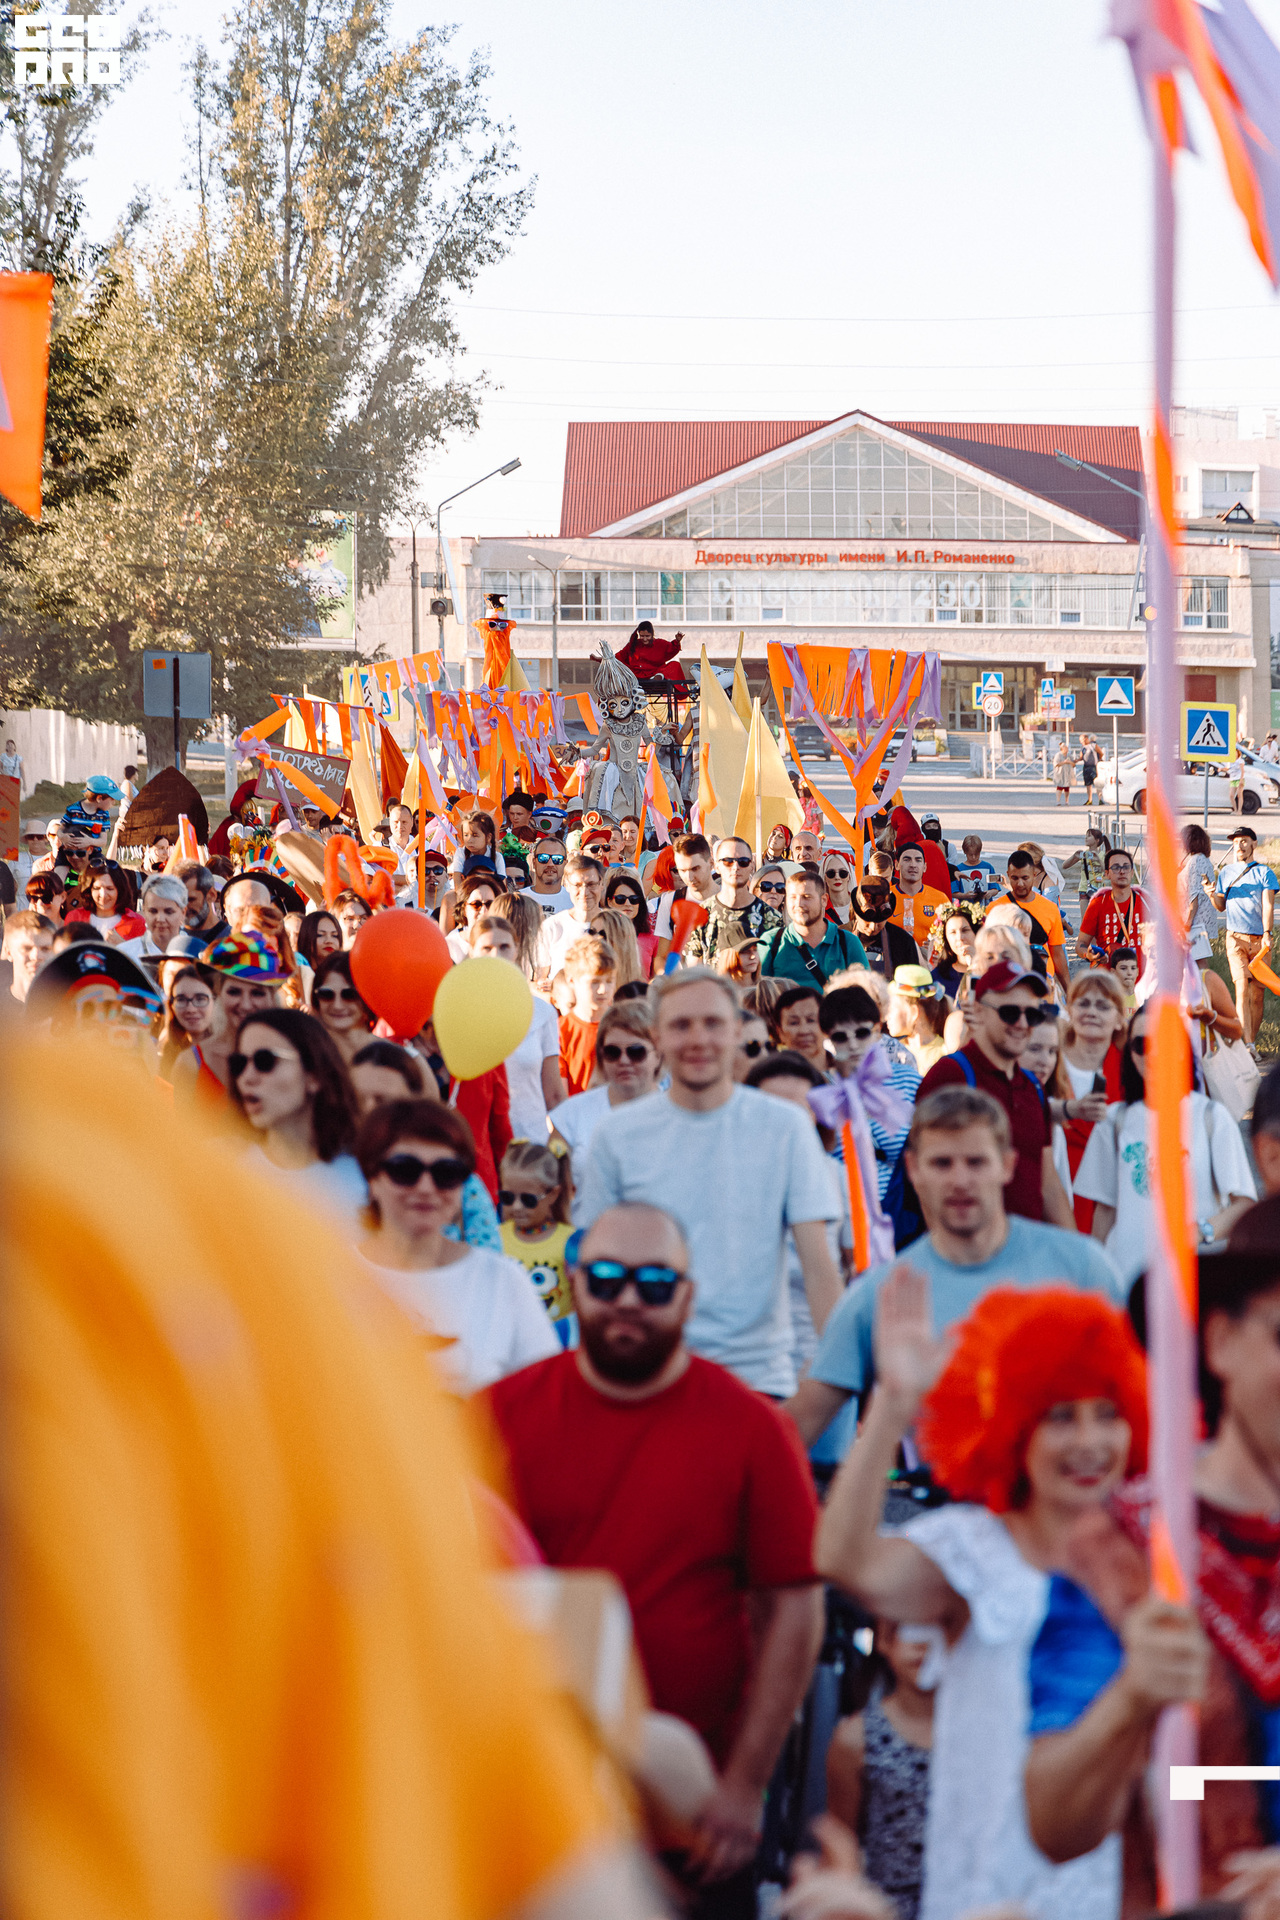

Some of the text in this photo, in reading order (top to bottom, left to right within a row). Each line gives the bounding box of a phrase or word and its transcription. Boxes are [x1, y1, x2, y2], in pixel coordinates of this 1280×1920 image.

[695, 550, 752, 566] Дворец
[756, 552, 828, 566] культуры
[839, 552, 885, 563] имени
[934, 550, 1015, 564] Романенко
[913, 579, 982, 609] 290
[987, 701, 1000, 710] 20
[1063, 696, 1073, 709] P
